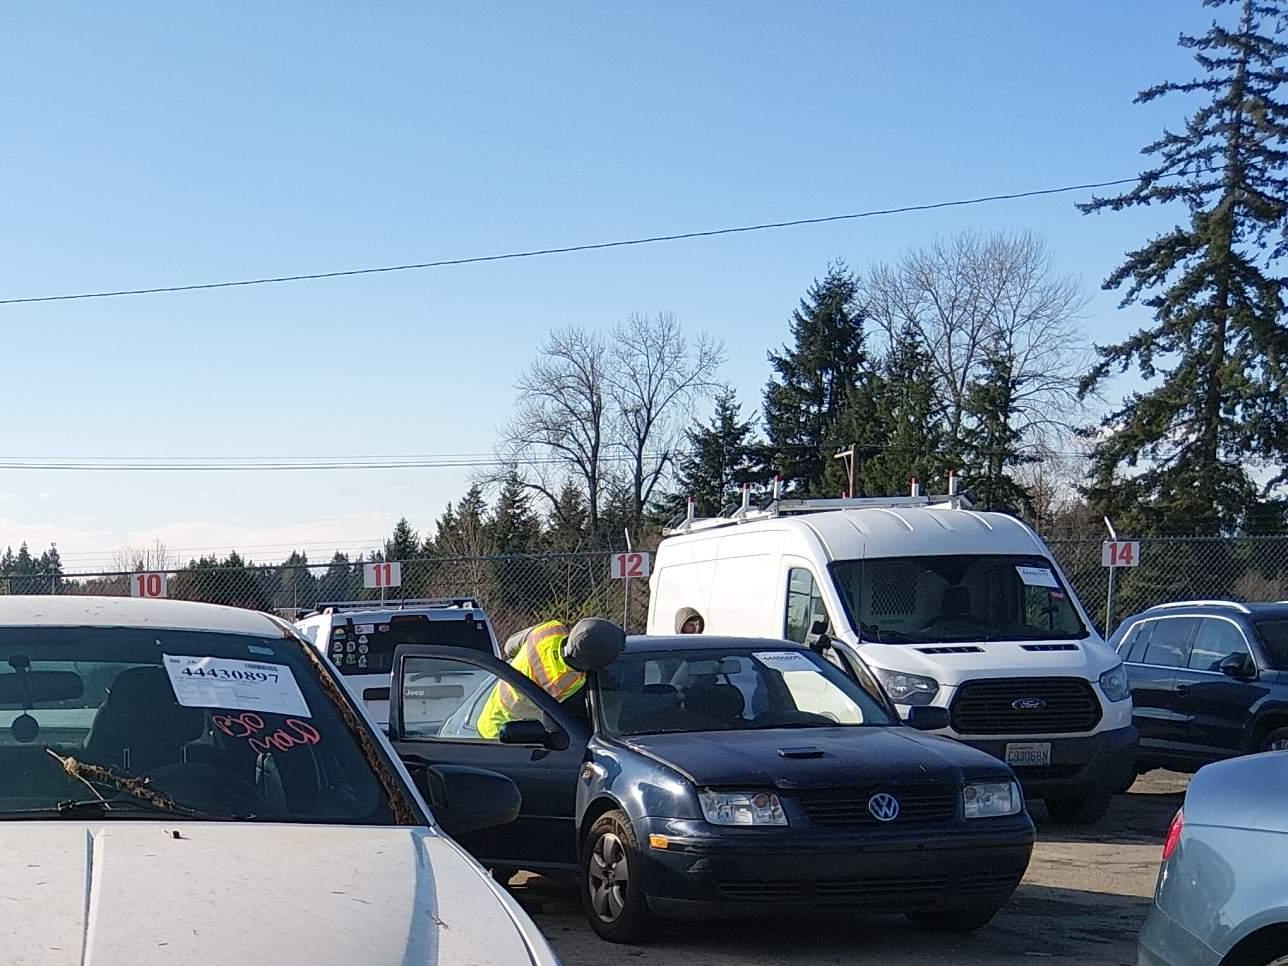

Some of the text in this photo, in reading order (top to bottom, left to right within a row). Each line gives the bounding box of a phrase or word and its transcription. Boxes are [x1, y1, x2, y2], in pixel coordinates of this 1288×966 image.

[617, 554, 643, 577] 12
[1109, 543, 1133, 565] 14
[136, 574, 162, 597] 10
[372, 563, 392, 587] 11
[181, 667, 279, 684] 44430897
